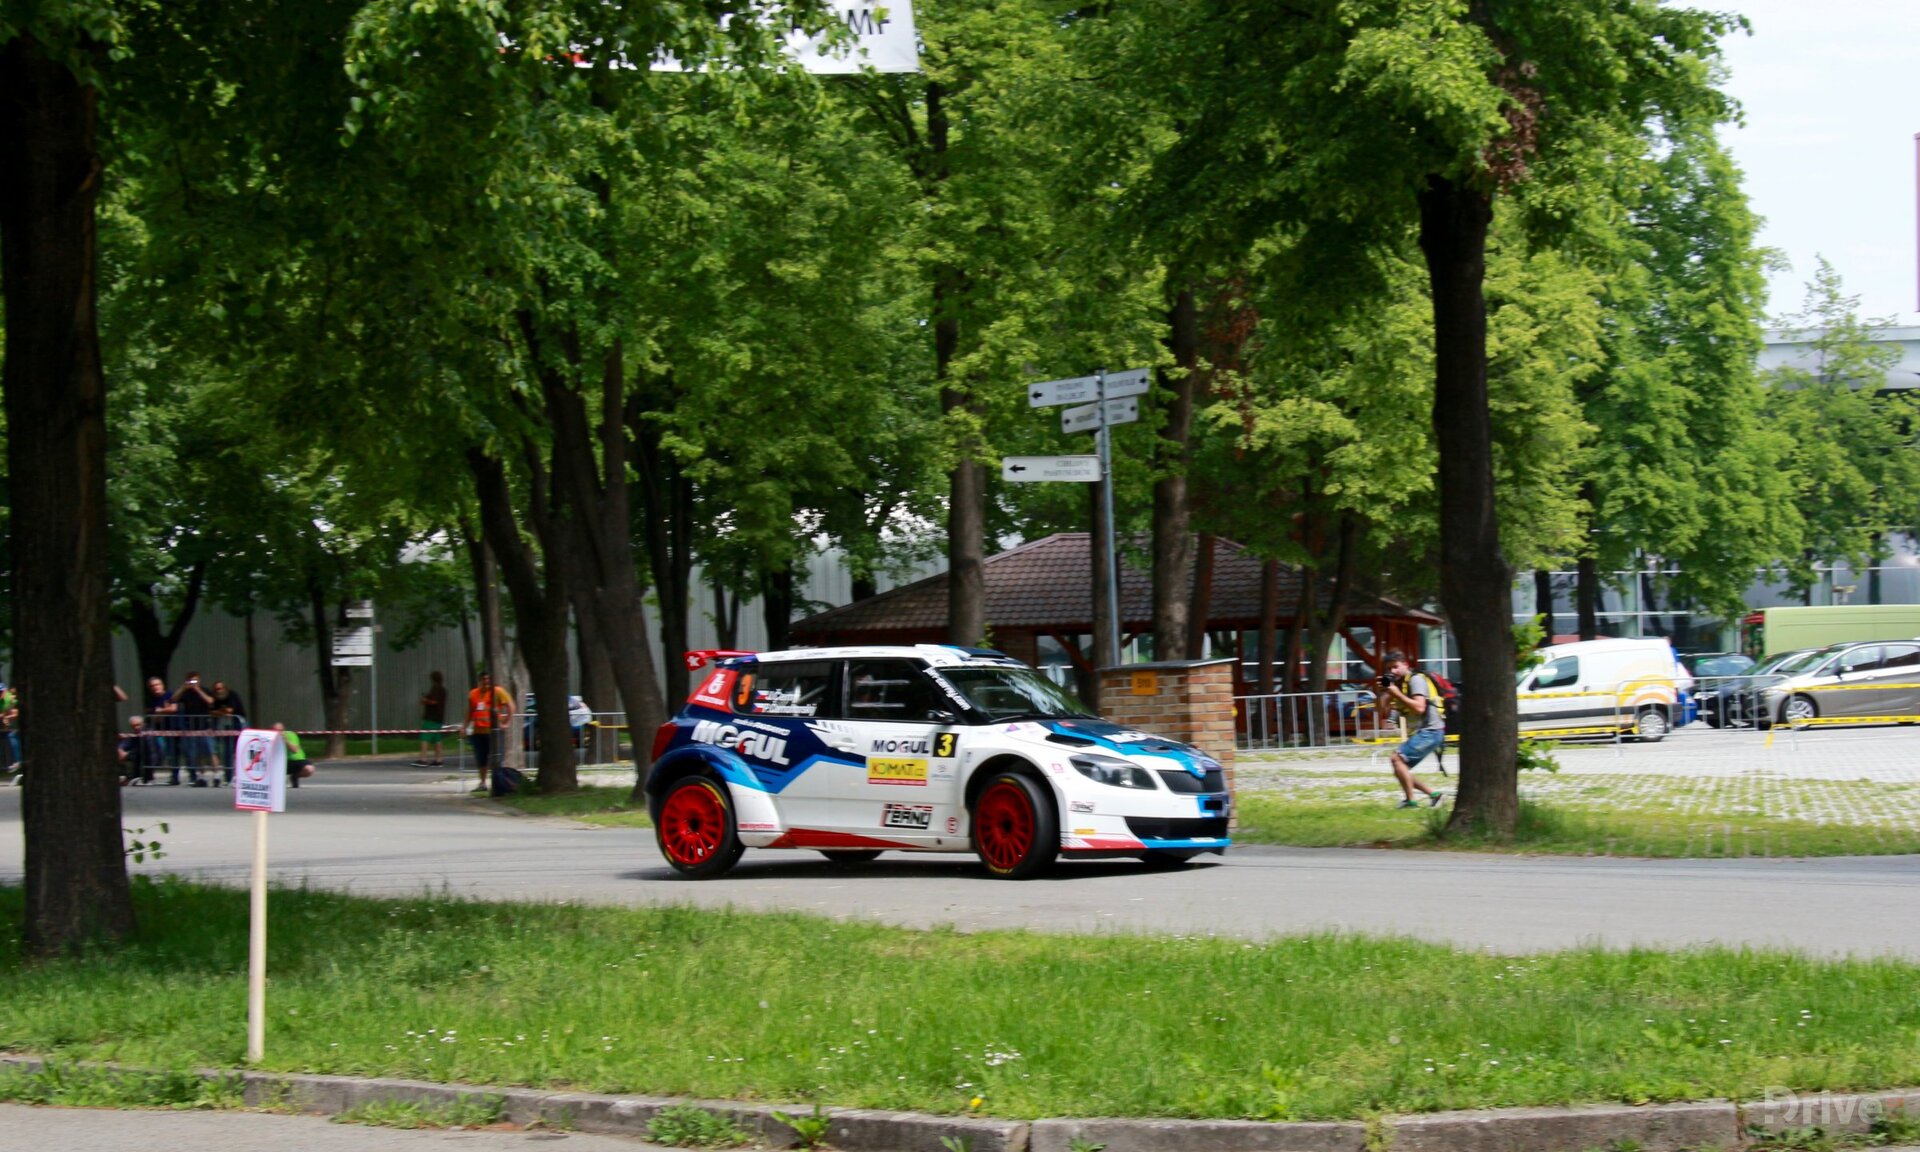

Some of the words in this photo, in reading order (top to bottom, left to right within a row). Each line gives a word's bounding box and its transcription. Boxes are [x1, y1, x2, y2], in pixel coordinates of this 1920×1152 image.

[691, 719, 790, 765] MOGUL
[871, 739, 930, 754] MOGUL
[937, 734, 954, 757] 3
